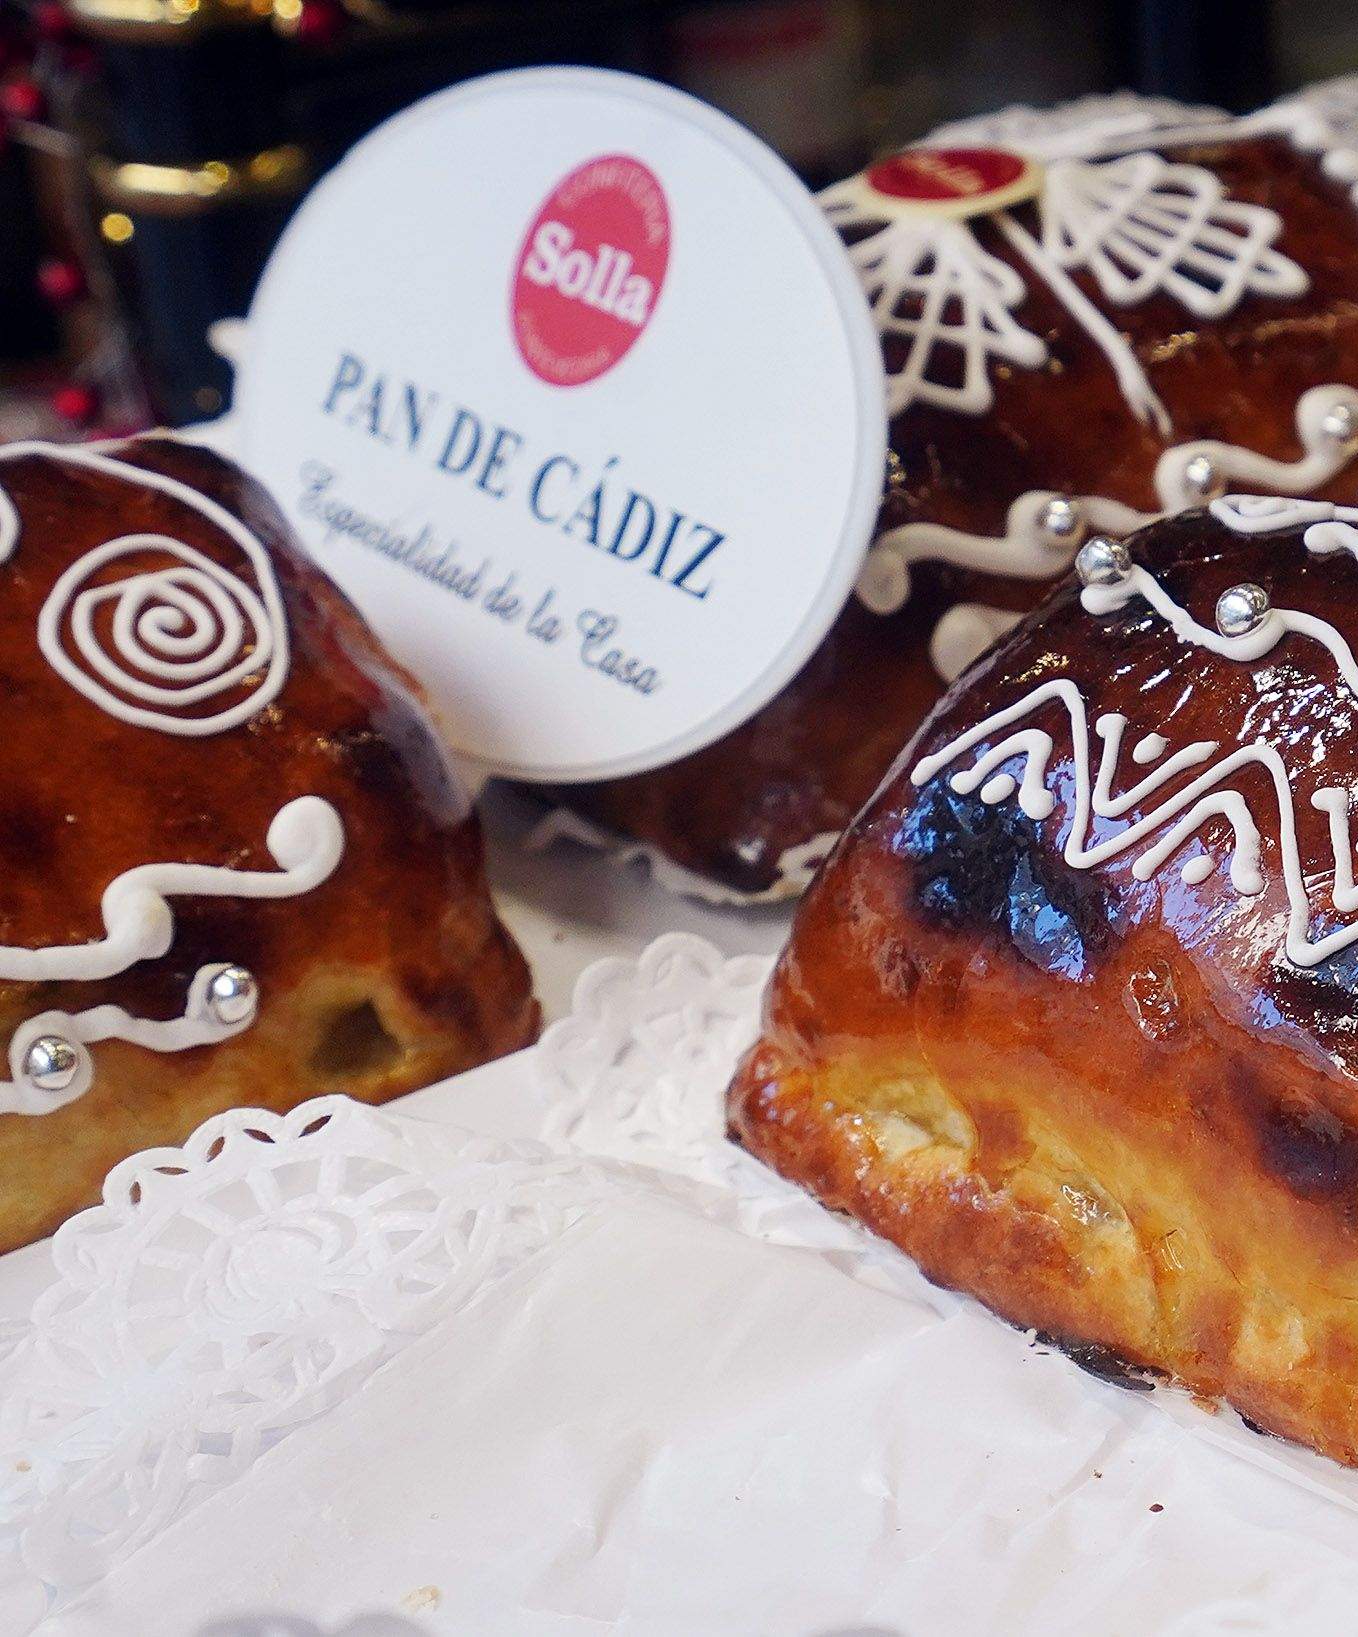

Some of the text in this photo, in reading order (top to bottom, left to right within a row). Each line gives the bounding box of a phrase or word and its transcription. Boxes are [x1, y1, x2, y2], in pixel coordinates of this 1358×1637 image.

[522, 219, 653, 326] Solla
[301, 461, 660, 695] Especialidad de la Casa
[323, 352, 727, 600] PAN DE CÁDIZ
